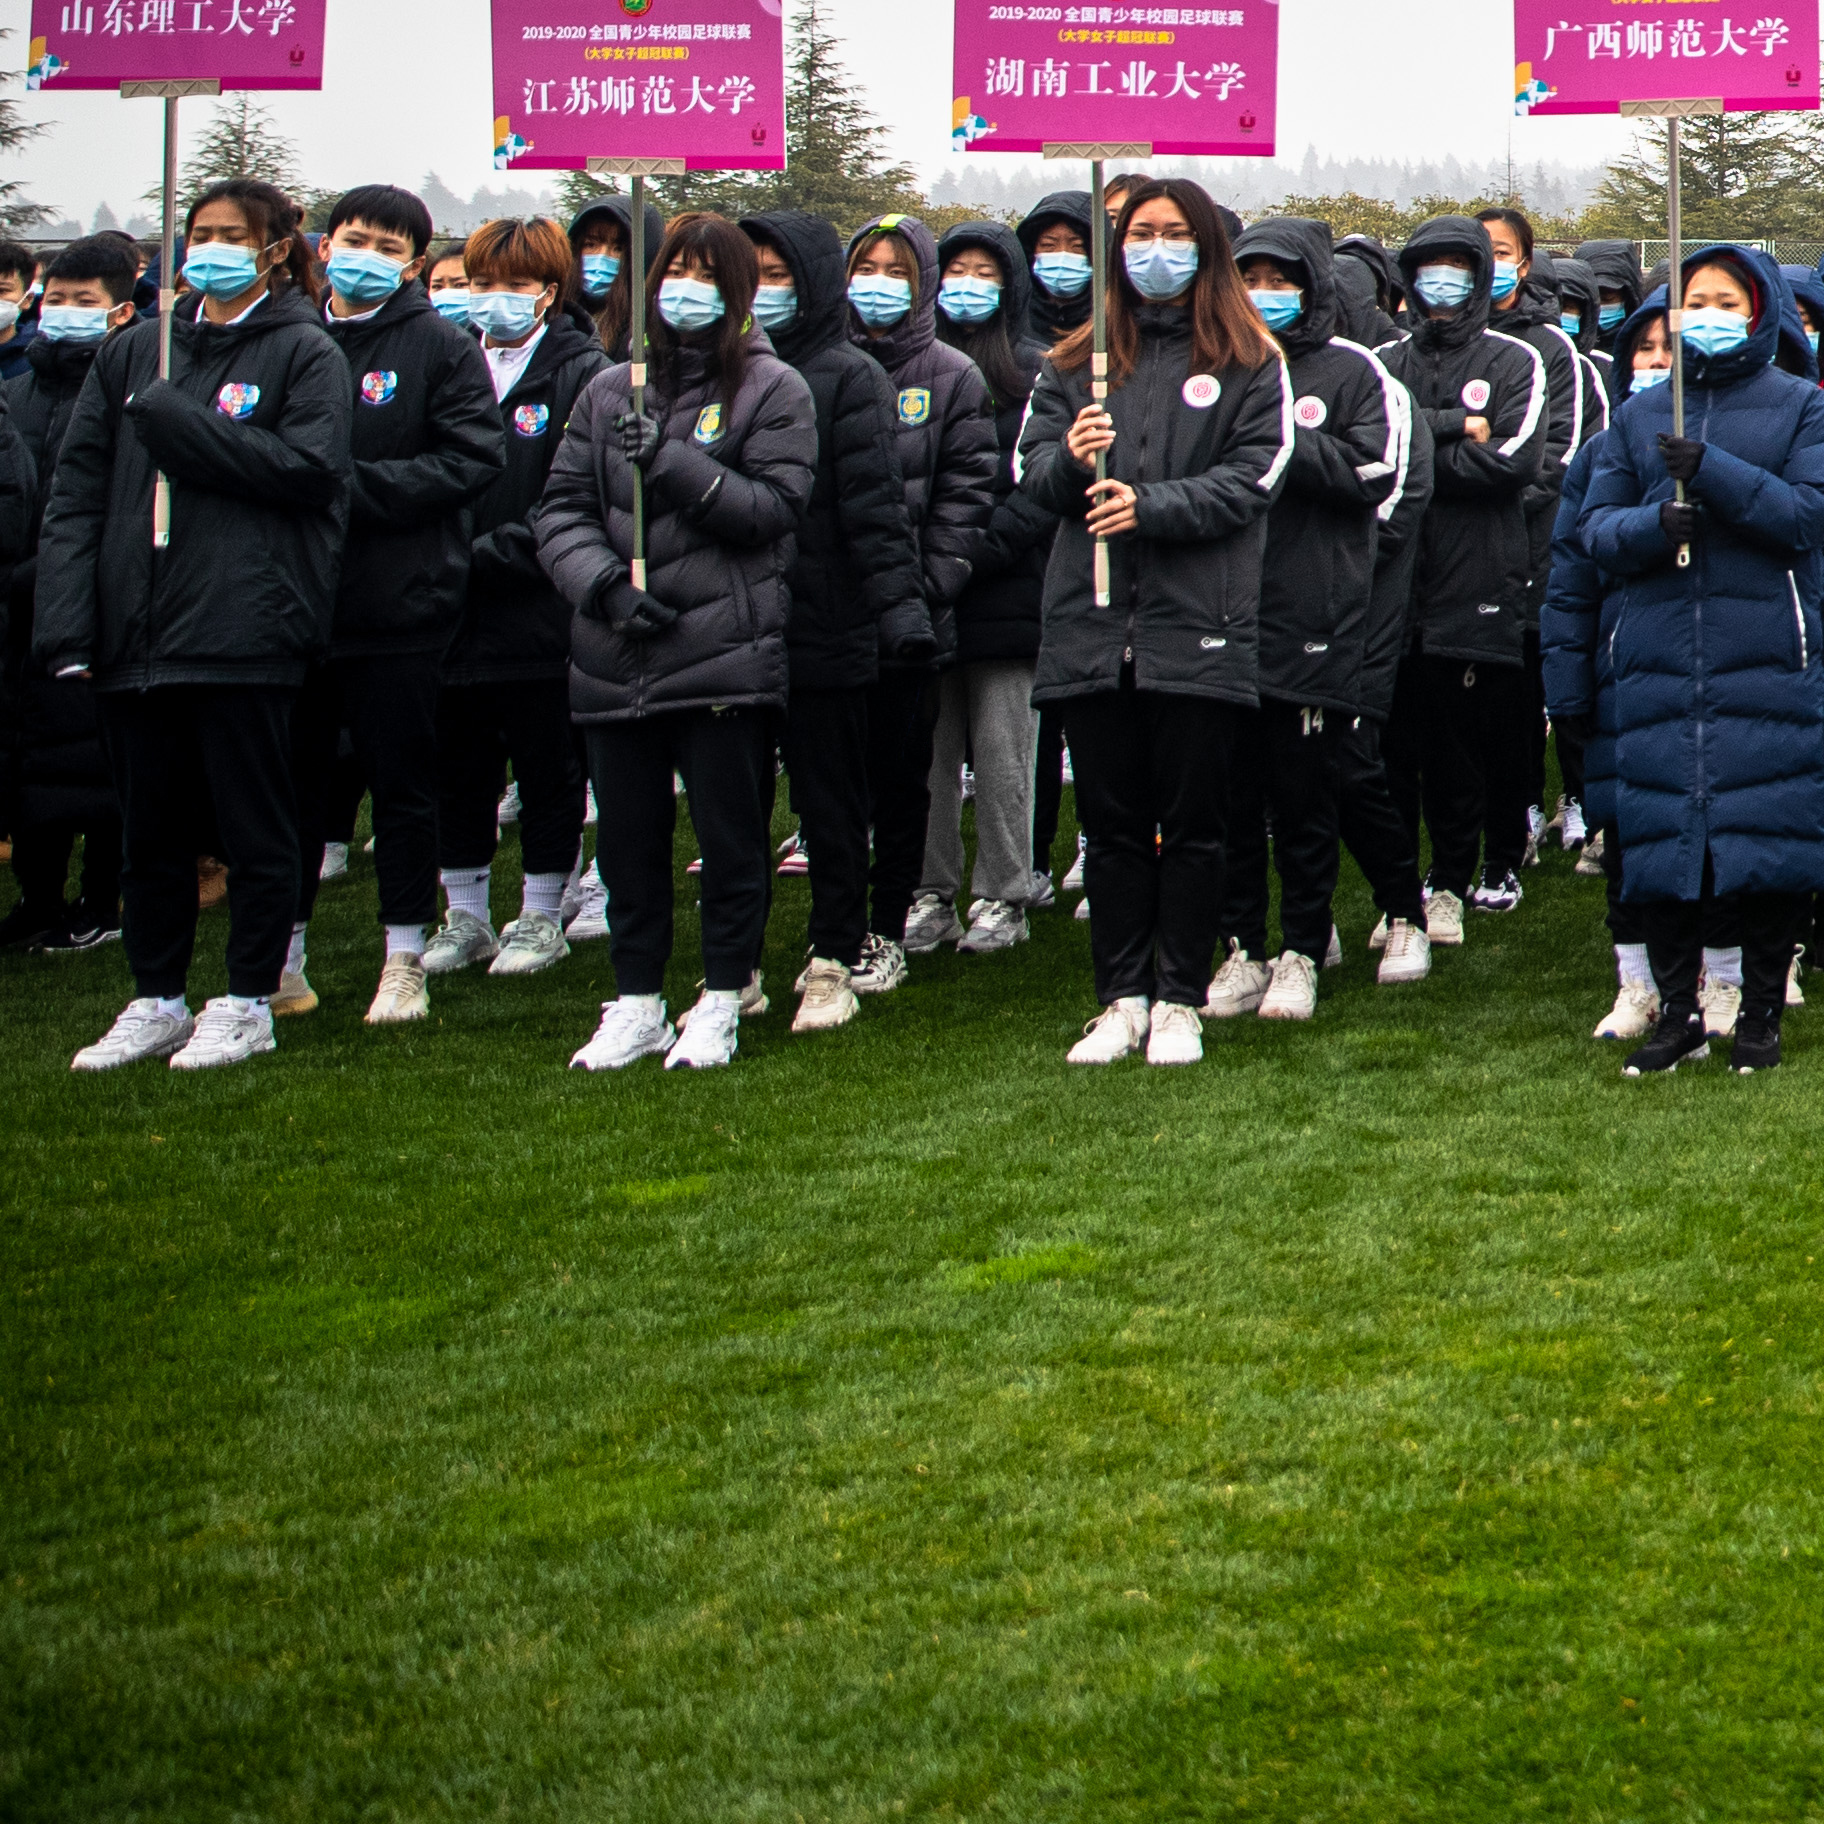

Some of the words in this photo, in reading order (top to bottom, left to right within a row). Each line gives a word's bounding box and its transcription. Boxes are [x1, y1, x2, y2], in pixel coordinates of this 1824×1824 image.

[989, 6, 1062, 21] 2019-2020
[1064, 6, 1244, 26] 全国青少年校园足球联赛
[523, 26, 587, 39] 2019-2020
[589, 24, 751, 40] 全国青少年校园足球联赛
[1544, 17, 1789, 60] 广西师范大学
[986, 57, 1246, 101] 湖南工业大学
[523, 75, 755, 115] 江苏师范大学
[1463, 663, 1476, 688] 6
[1299, 706, 1324, 737] 14
